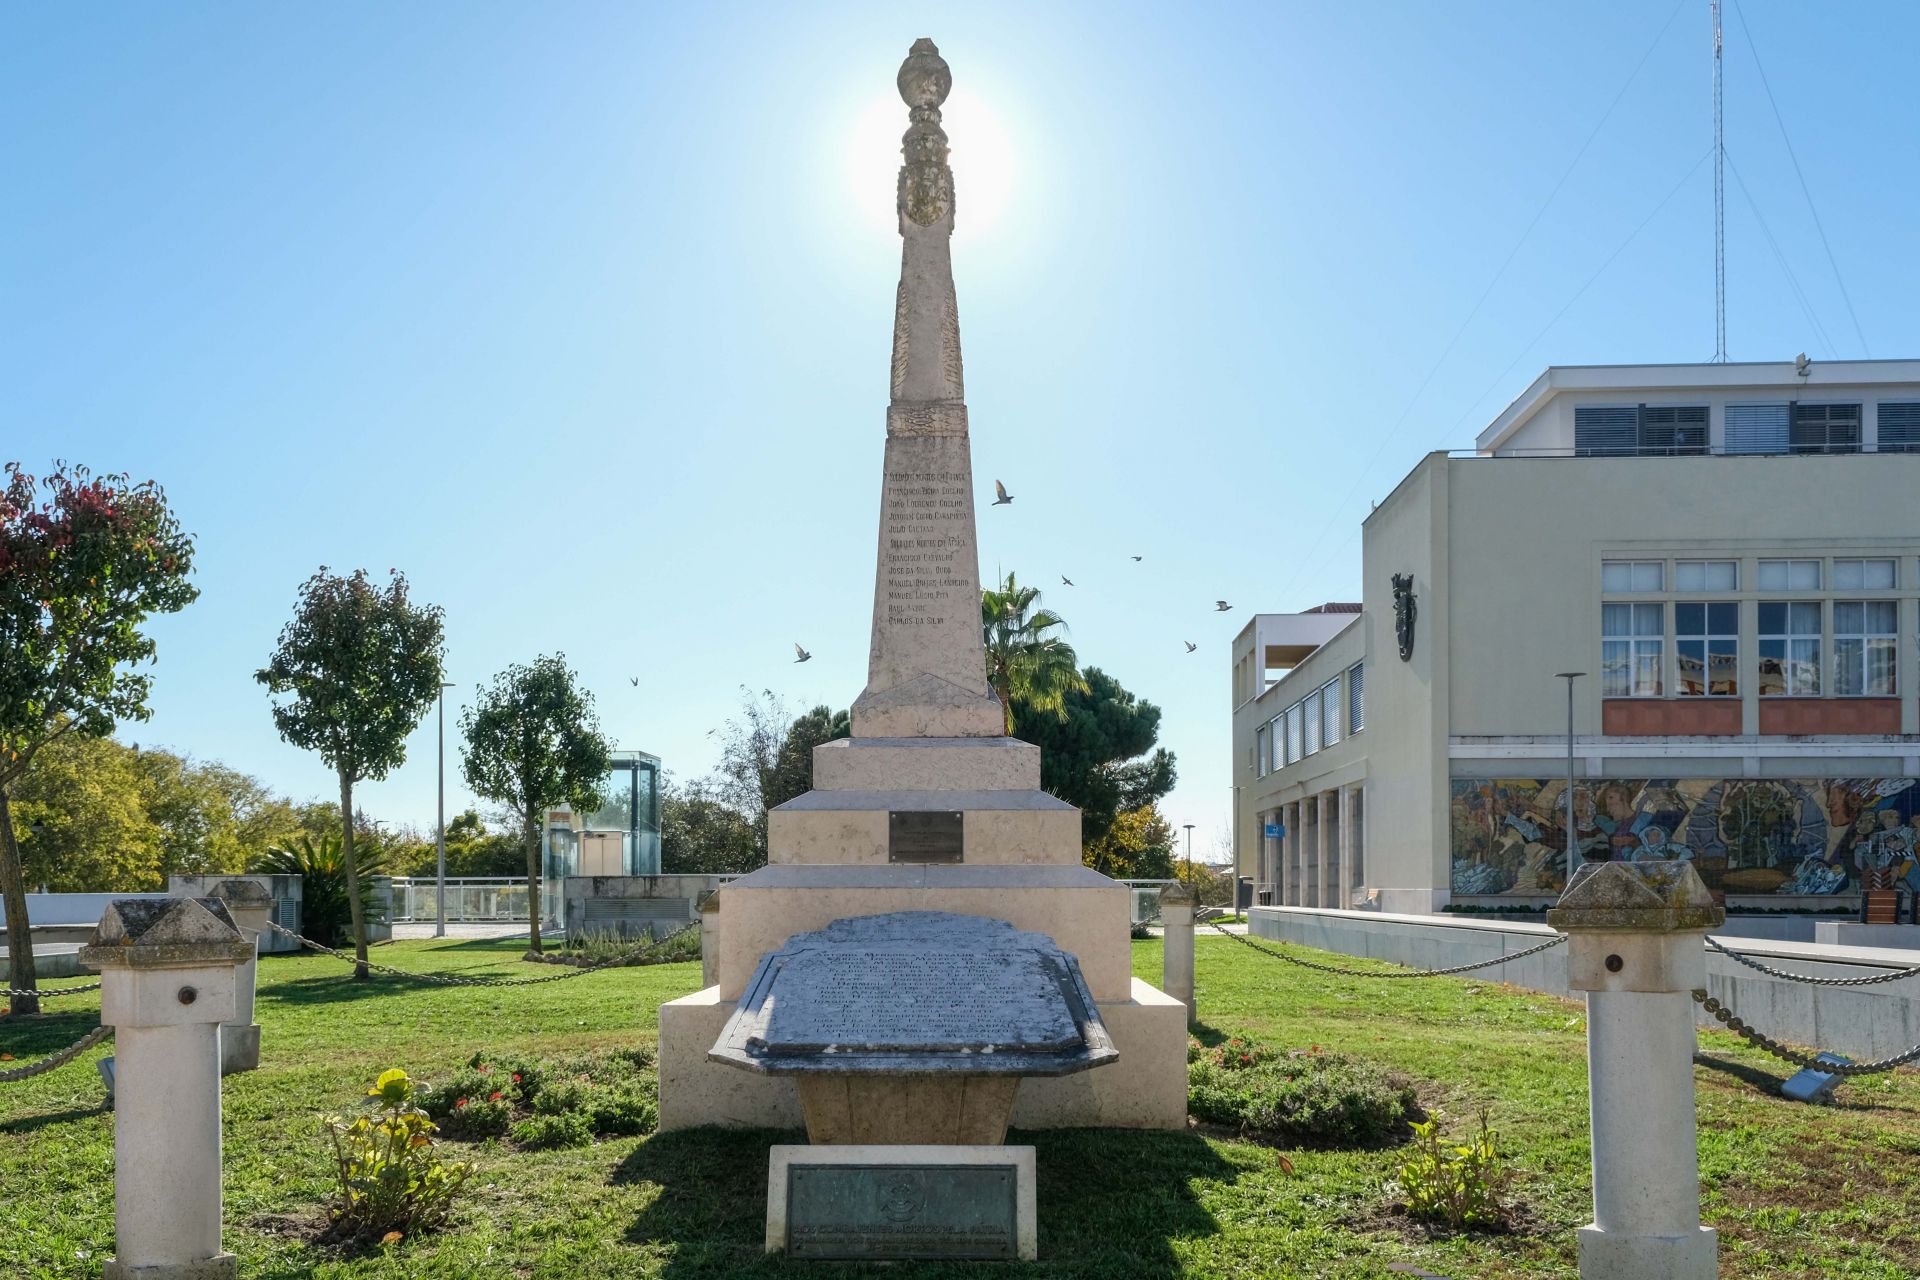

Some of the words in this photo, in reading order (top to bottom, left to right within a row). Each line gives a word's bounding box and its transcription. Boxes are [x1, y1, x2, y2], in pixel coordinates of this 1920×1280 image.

[939, 499, 963, 508] COELHO
[888, 578, 913, 588] MANUEL
[888, 591, 913, 600] MANUEL
[888, 616, 913, 625] CARLOS
[914, 617, 924, 625] DA
[926, 616, 945, 625] SILVA
[894, 1224, 940, 1234] MORTOS
